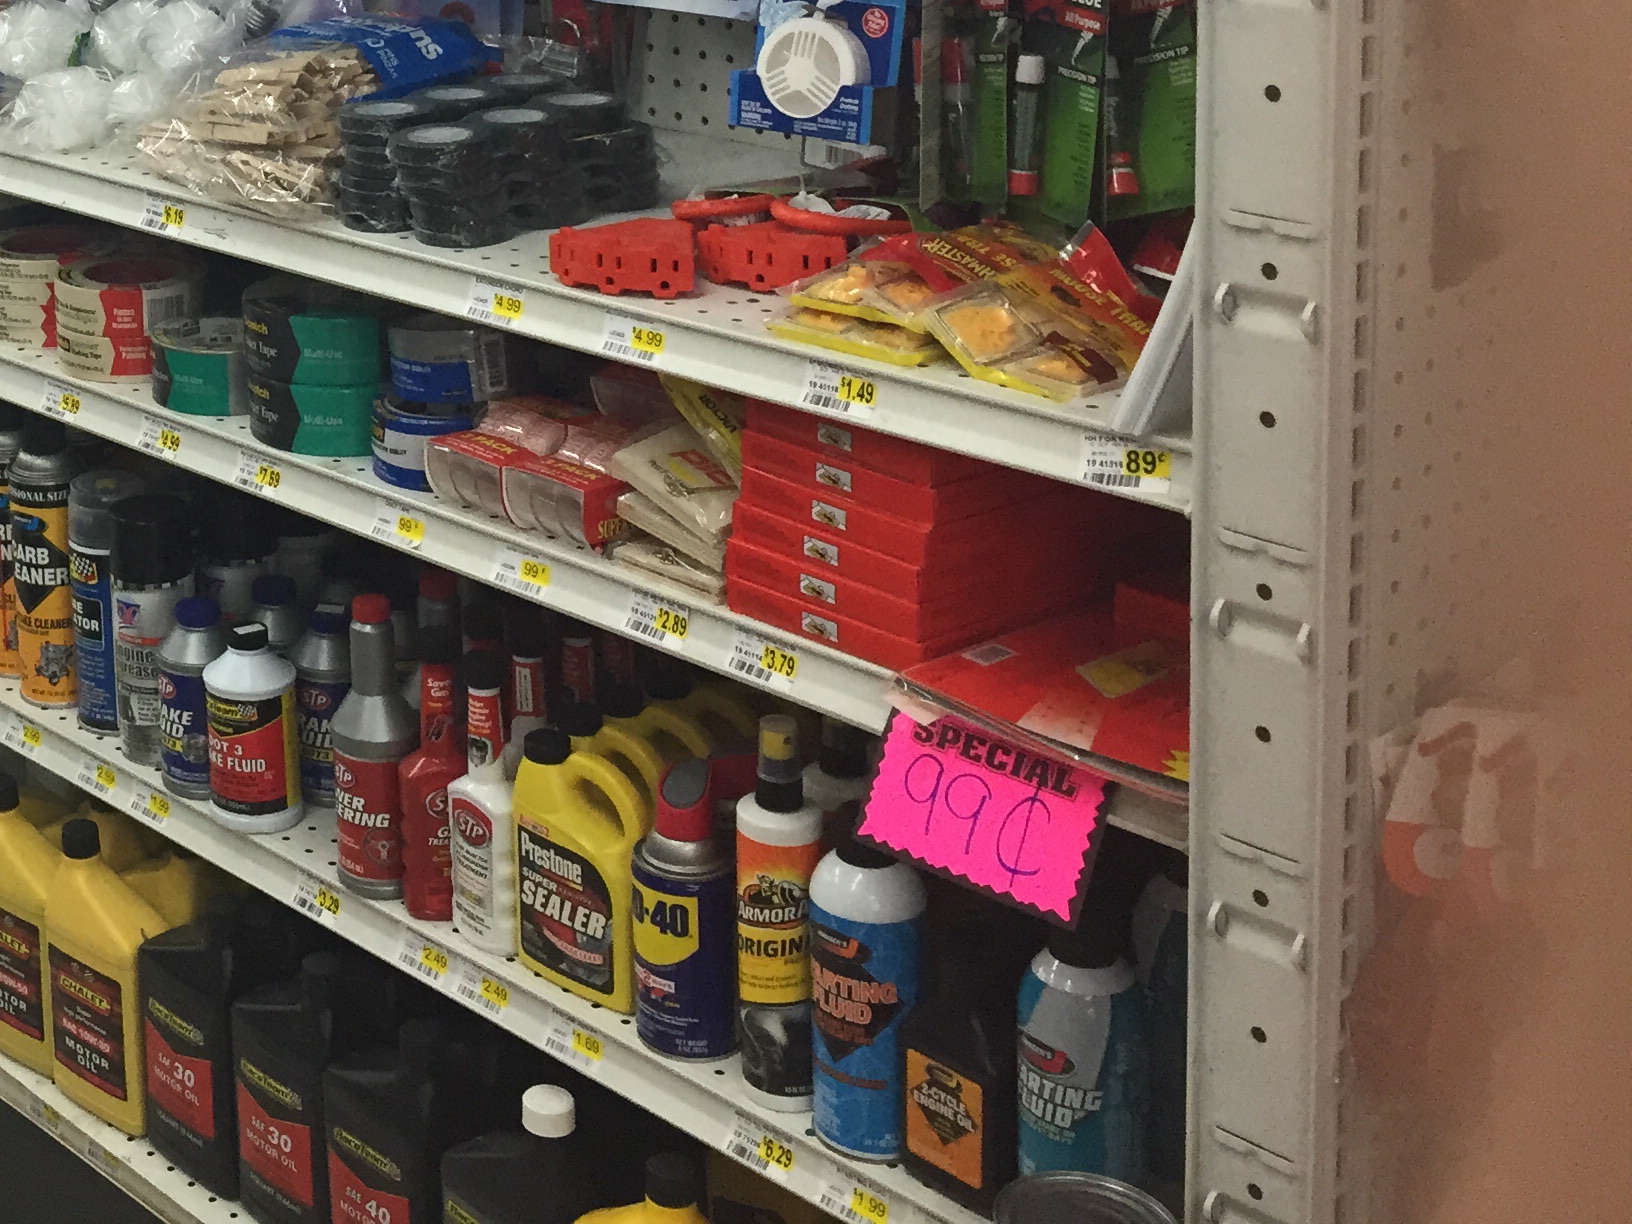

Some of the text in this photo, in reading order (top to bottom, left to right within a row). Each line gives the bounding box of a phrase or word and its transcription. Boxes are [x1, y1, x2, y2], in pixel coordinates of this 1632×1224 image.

[633, 327, 663, 348] $4.99
[840, 377, 875, 404] $1.49
[1126, 449, 1167, 476] 89¢
[657, 606, 688, 639] $2.89
[764, 644, 797, 679] $3.79
[228, 756, 266, 773] FLUID
[234, 744, 243, 756] 3
[911, 717, 1079, 797] SPECIAL
[455, 811, 485, 840] STP
[521, 829, 583, 884] Prestone
[522, 867, 558, 894] SUPER
[521, 879, 609, 941] SEALER
[632, 885, 690, 939] D-40
[60, 975, 105, 1008] CHALET
[65, 1035, 110, 1071] MOTOR
[77, 1053, 98, 1075] OIL
[173, 1061, 196, 1089] 30
[184, 1088, 200, 1107] OIL
[913, 1089, 955, 1122] ENGINE
[920, 1084, 967, 1114] 2-CYCLE
[246, 1127, 298, 1173] MOTOR OIL
[268, 1125, 293, 1153] 30
[763, 1135, 793, 1170] $6.29
[345, 1186, 391, 1224] SAE 40
[853, 1186, 887, 1219] $1.99
